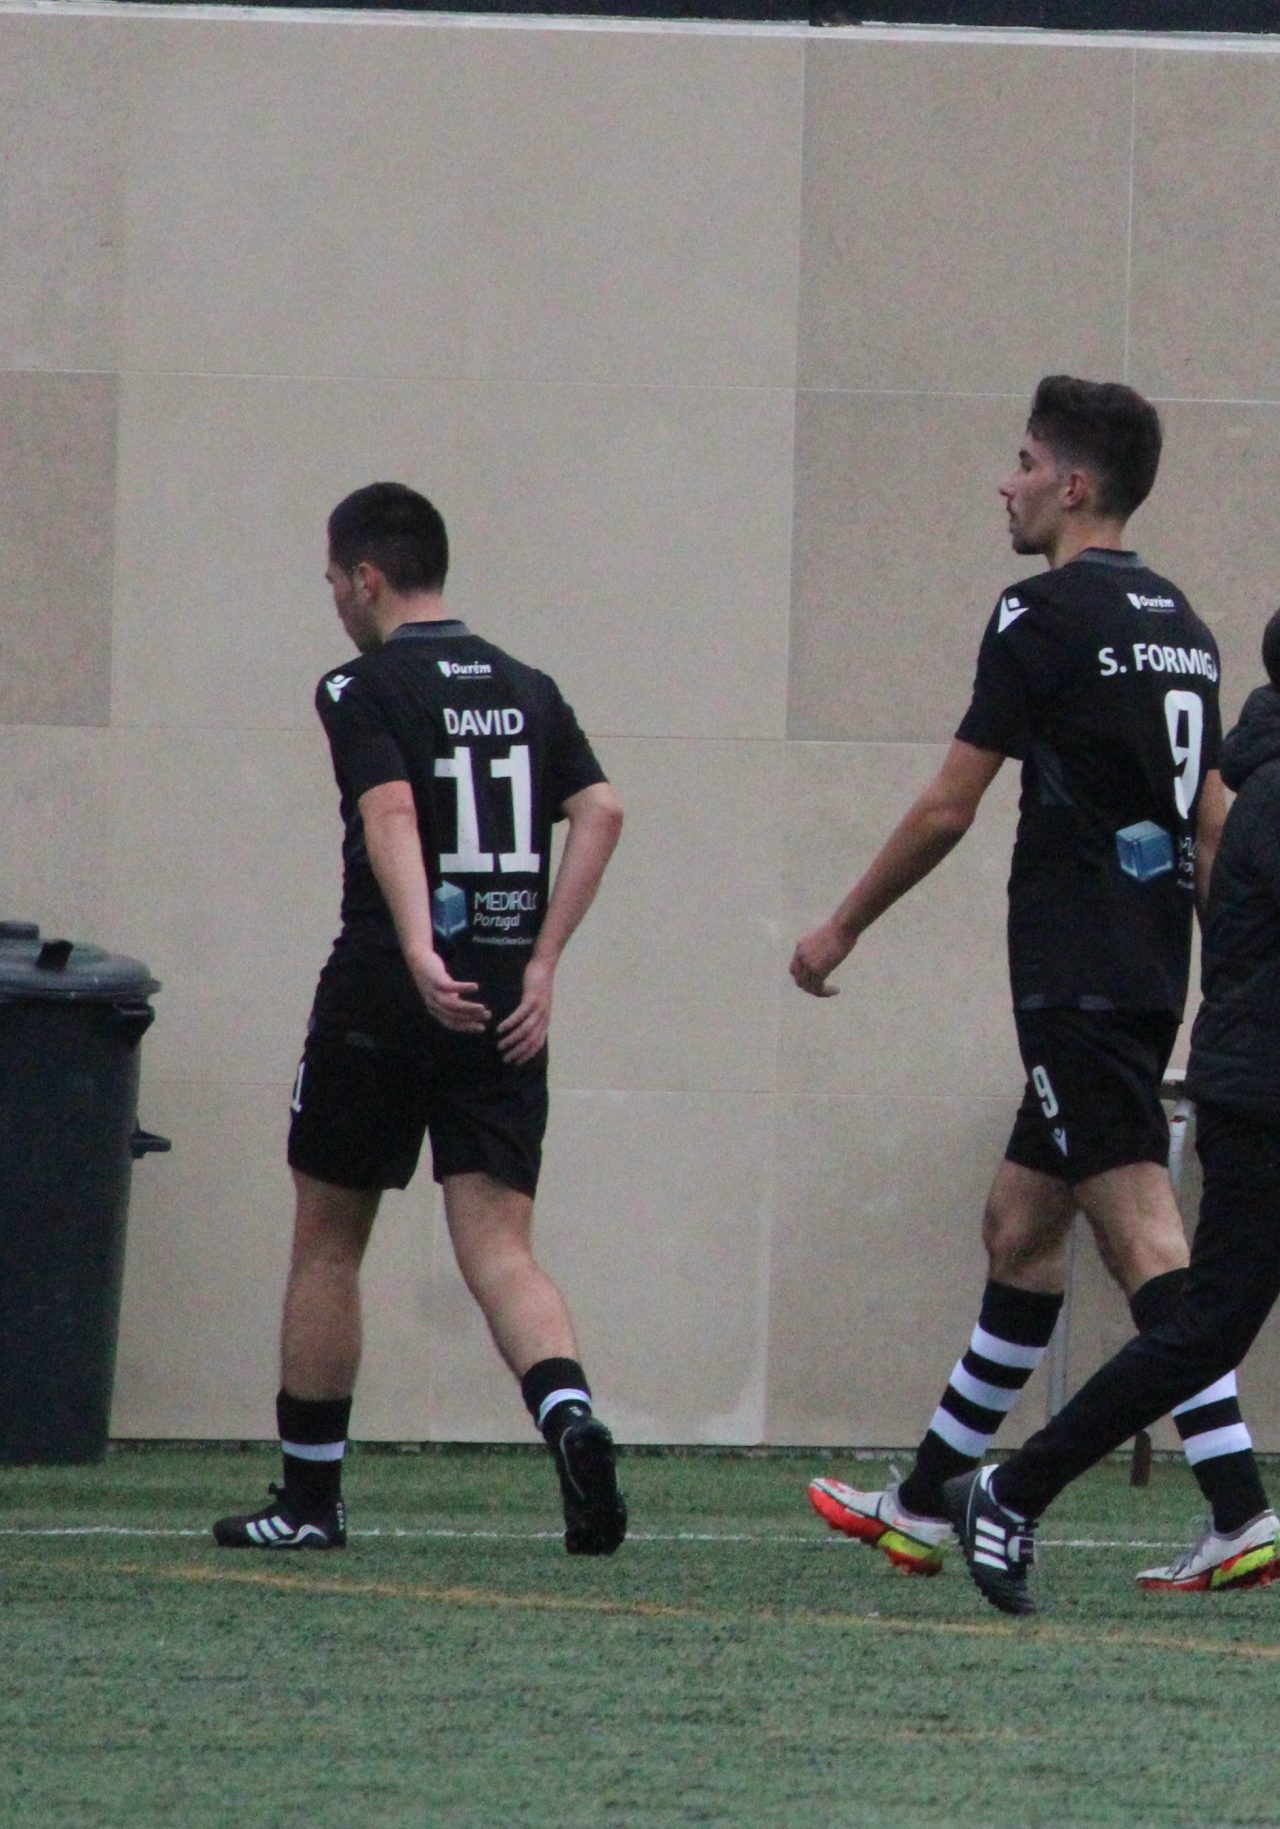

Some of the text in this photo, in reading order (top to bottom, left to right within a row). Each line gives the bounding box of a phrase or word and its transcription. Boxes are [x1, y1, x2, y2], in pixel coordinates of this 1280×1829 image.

[451, 660, 492, 674] Ourém
[1098, 647, 1127, 676] S.
[443, 708, 524, 736] DAVID
[1164, 689, 1203, 819] 9
[434, 745, 540, 873] 11
[473, 912, 520, 931] Portugal
[1032, 1065, 1059, 1119] 9
